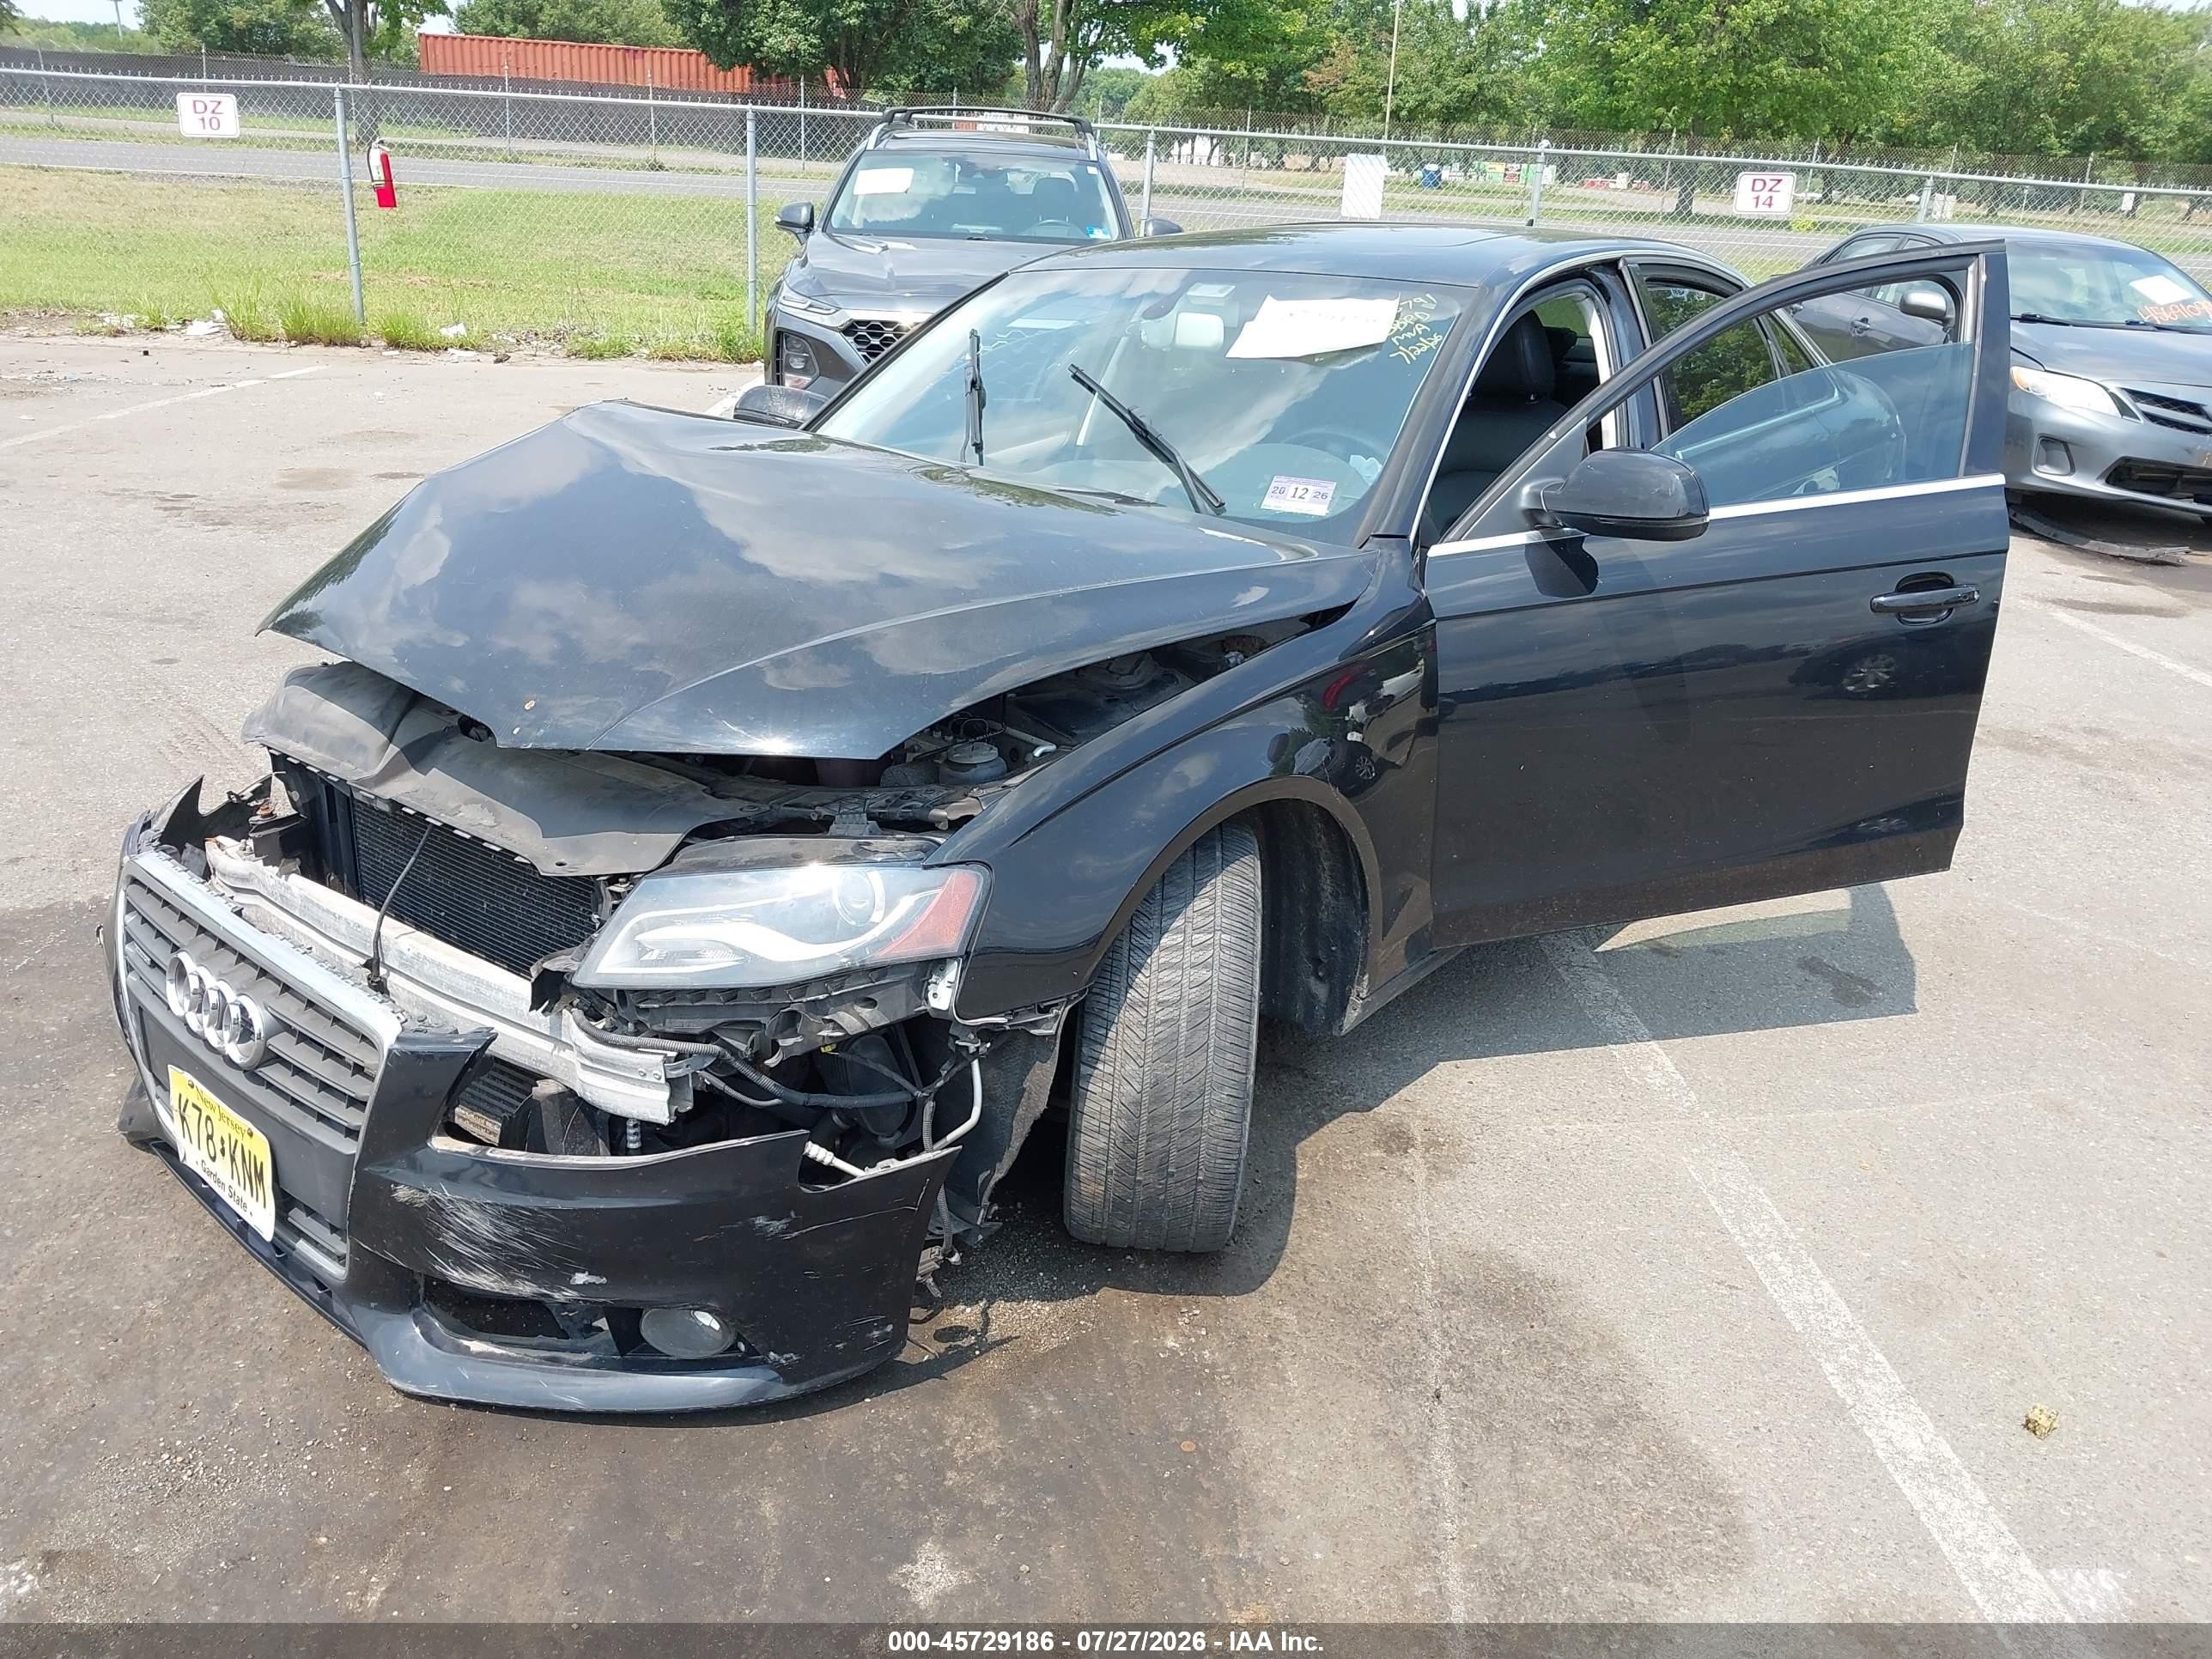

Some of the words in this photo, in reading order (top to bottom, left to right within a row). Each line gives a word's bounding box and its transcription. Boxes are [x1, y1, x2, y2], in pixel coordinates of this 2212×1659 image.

[192, 100, 223, 114] DZ
[198, 116, 221, 131] 10
[1751, 179, 1783, 192] DZ
[1753, 195, 1773, 209] 14
[1271, 486, 1286, 495] 20
[1291, 487, 1309, 500] 12
[1312, 491, 1328, 500] 26
[195, 1086, 217, 1111] New
[217, 1105, 246, 1140] Jersey
[200, 1159, 226, 1193] Garden
[228, 1185, 248, 1212] State
